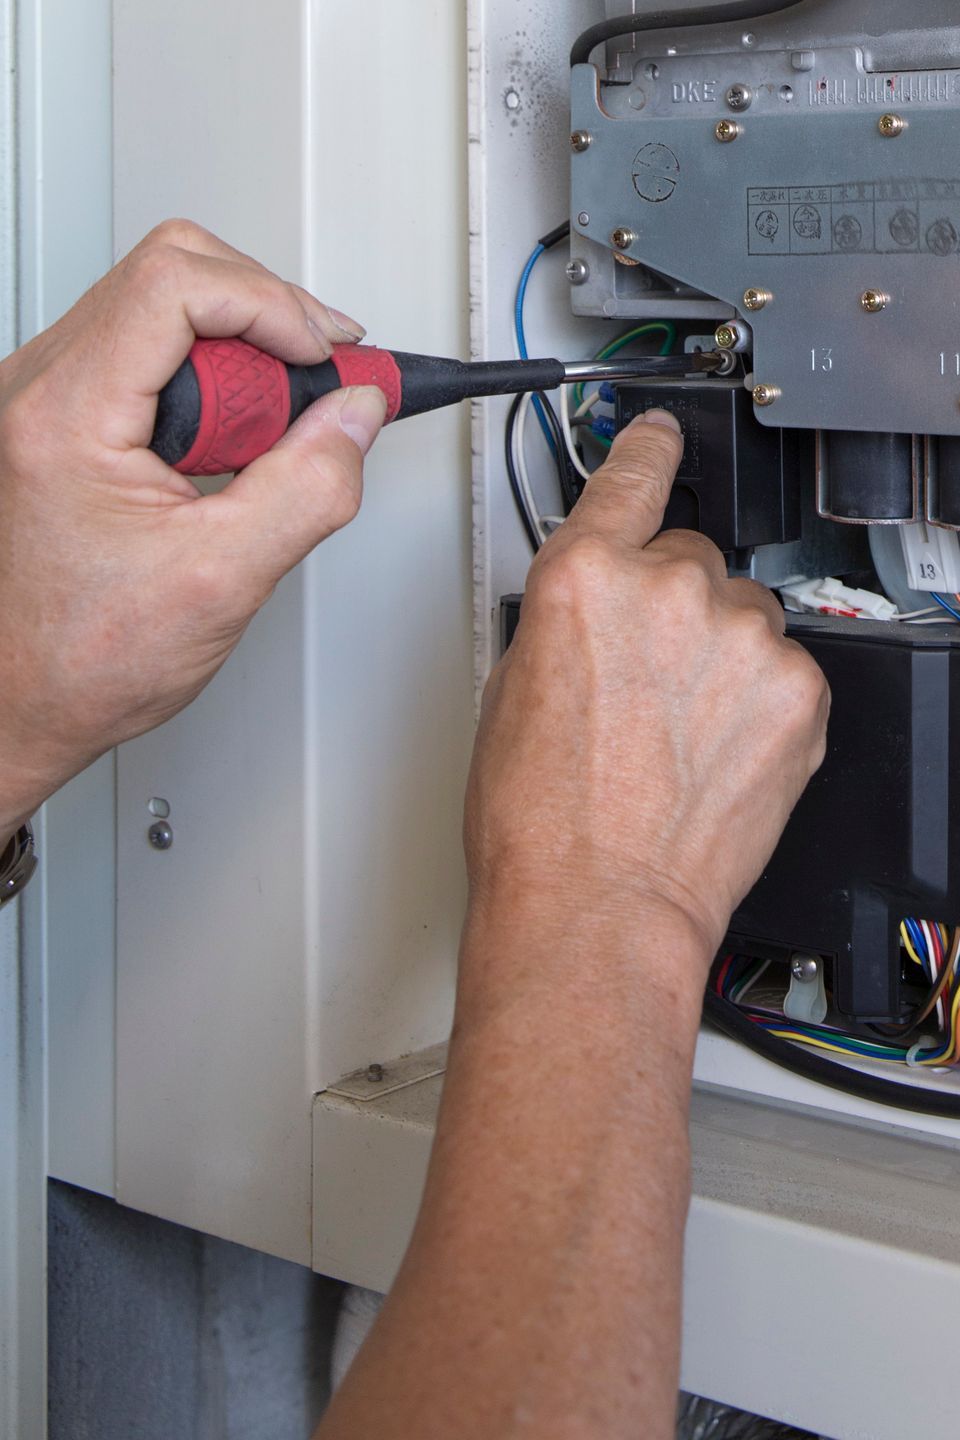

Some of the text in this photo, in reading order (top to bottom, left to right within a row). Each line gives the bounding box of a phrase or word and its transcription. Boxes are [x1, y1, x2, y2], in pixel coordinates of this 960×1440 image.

[671, 80, 718, 104] DKE
[810, 348, 833, 372] 13
[939, 351, 960, 376] 11
[918, 563, 937, 581] 13
